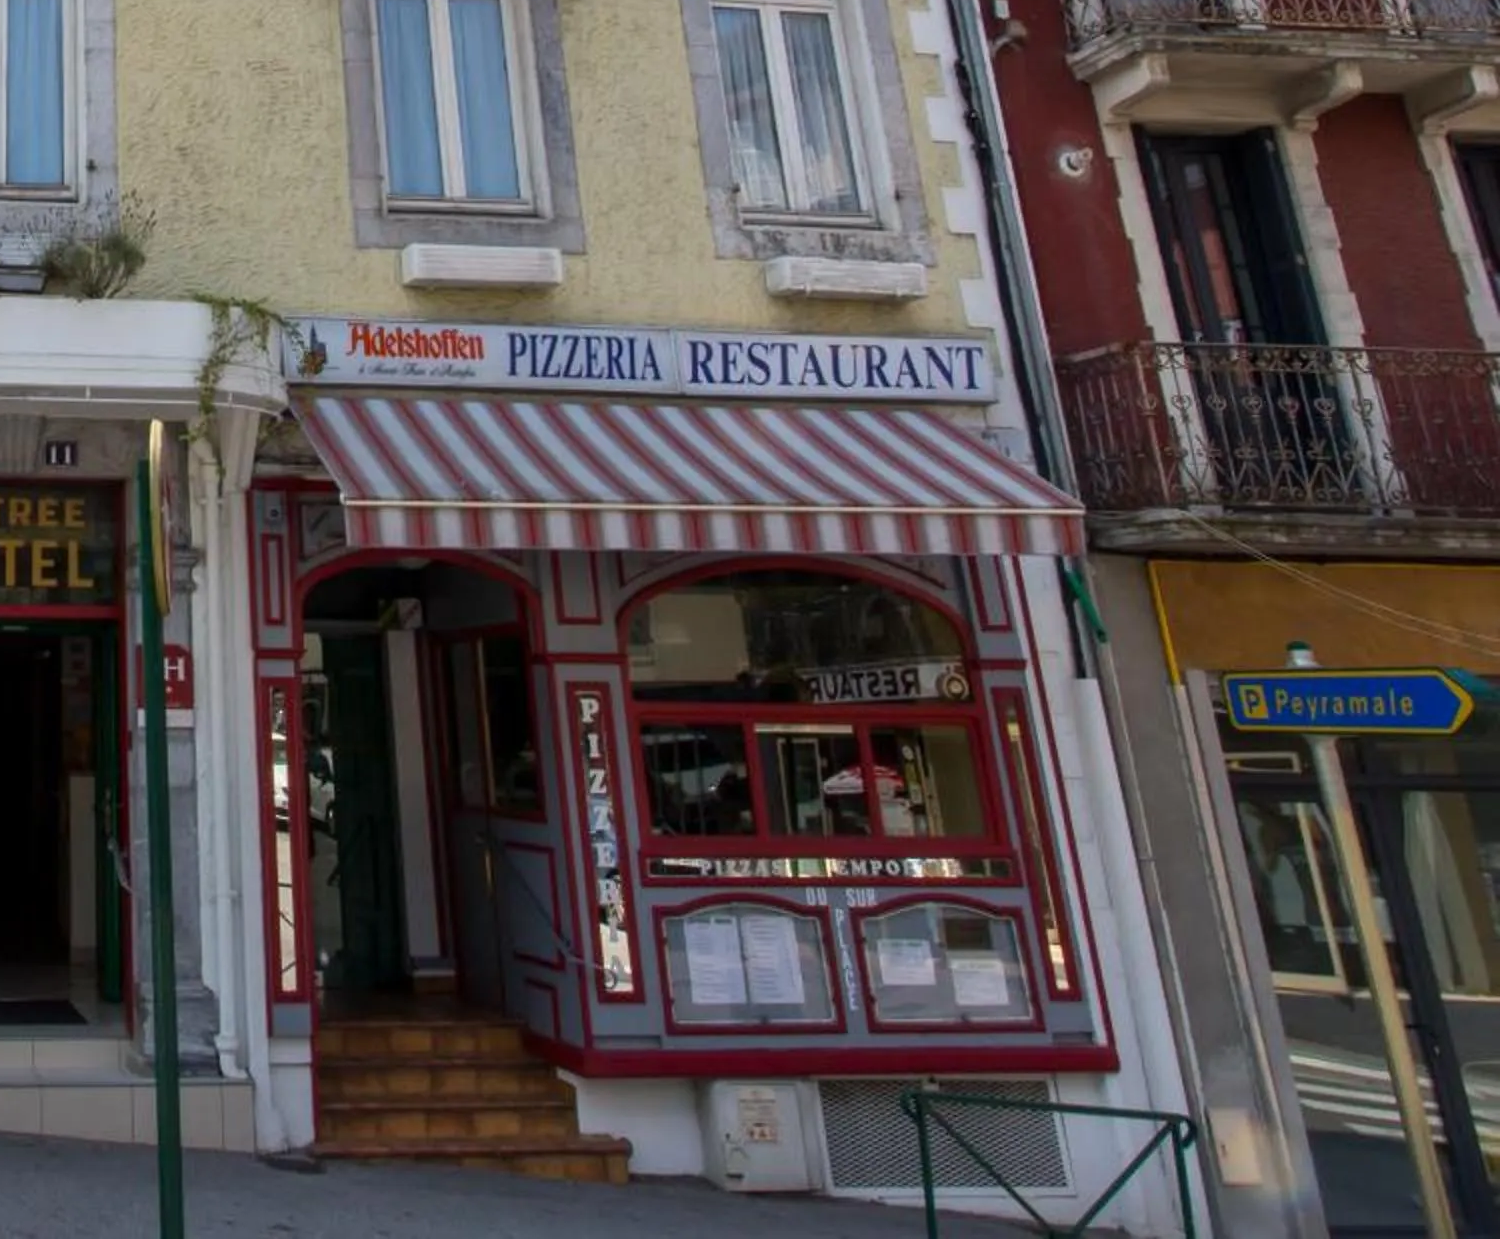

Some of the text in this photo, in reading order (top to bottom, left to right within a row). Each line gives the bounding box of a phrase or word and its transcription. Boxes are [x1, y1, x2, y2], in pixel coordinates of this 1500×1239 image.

[346, 323, 485, 360] Adelshoffen
[507, 332, 984, 391] PIZZERIA RESTAURANT
[51, 445, 71, 464] 11
[1274, 687, 1414, 720] Peyramale
[579, 697, 632, 979] PIZZERIA
[700, 858, 784, 878] PIZZAS
[845, 887, 878, 907] SUR
